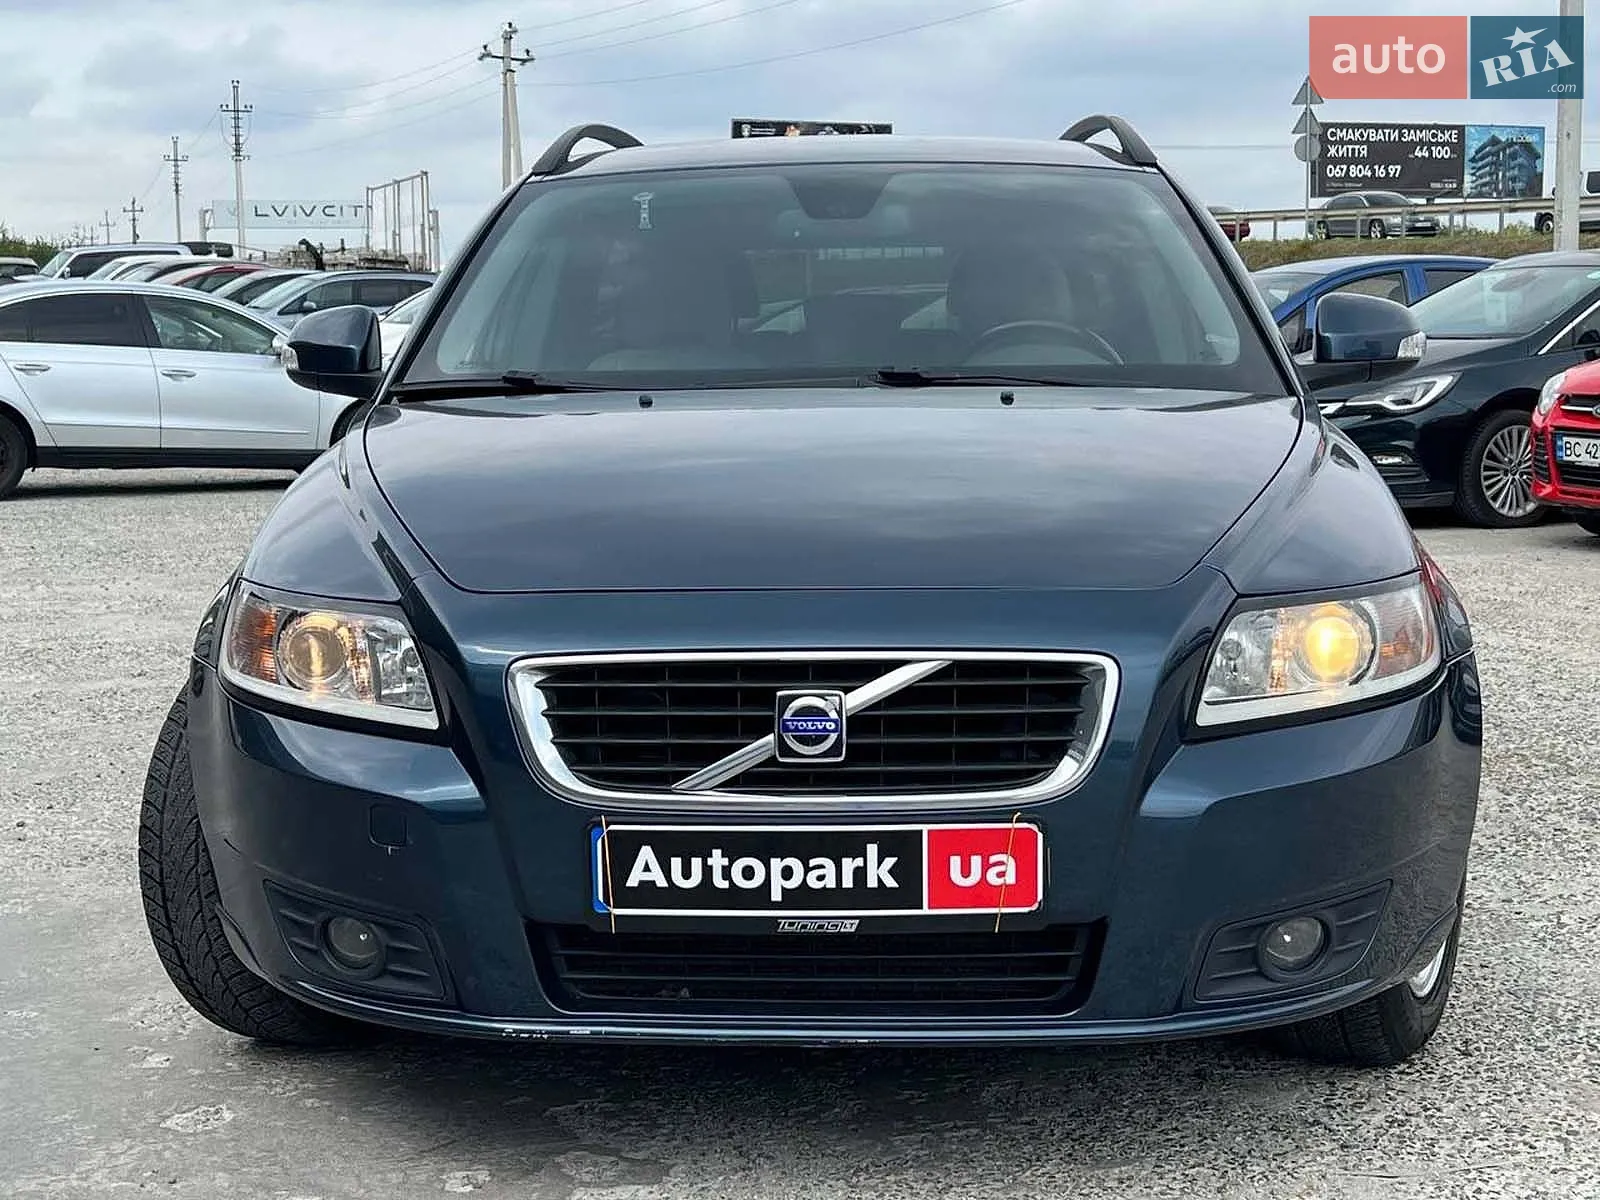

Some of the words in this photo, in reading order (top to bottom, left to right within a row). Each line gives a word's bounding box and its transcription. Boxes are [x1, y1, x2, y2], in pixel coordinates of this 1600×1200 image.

[1326, 128, 1399, 142] СМАКУВАТИ
[1401, 129, 1459, 143] ЗАМІСЬКЕ
[1327, 144, 1368, 158] ЖИТТЯ
[1414, 146, 1429, 158] 44
[1431, 146, 1451, 159] 100
[1326, 164, 1346, 178] 067
[1349, 164, 1371, 178] 804
[1373, 165, 1386, 178] 16
[1388, 165, 1401, 178] 97
[253, 204, 372, 218] LVIVCIT
[1564, 441, 1582, 458] BC
[1585, 442, 1600, 460] 42
[785, 721, 836, 730] VOLVO
[625, 843, 900, 902] Autopark
[949, 854, 1017, 888] ua
